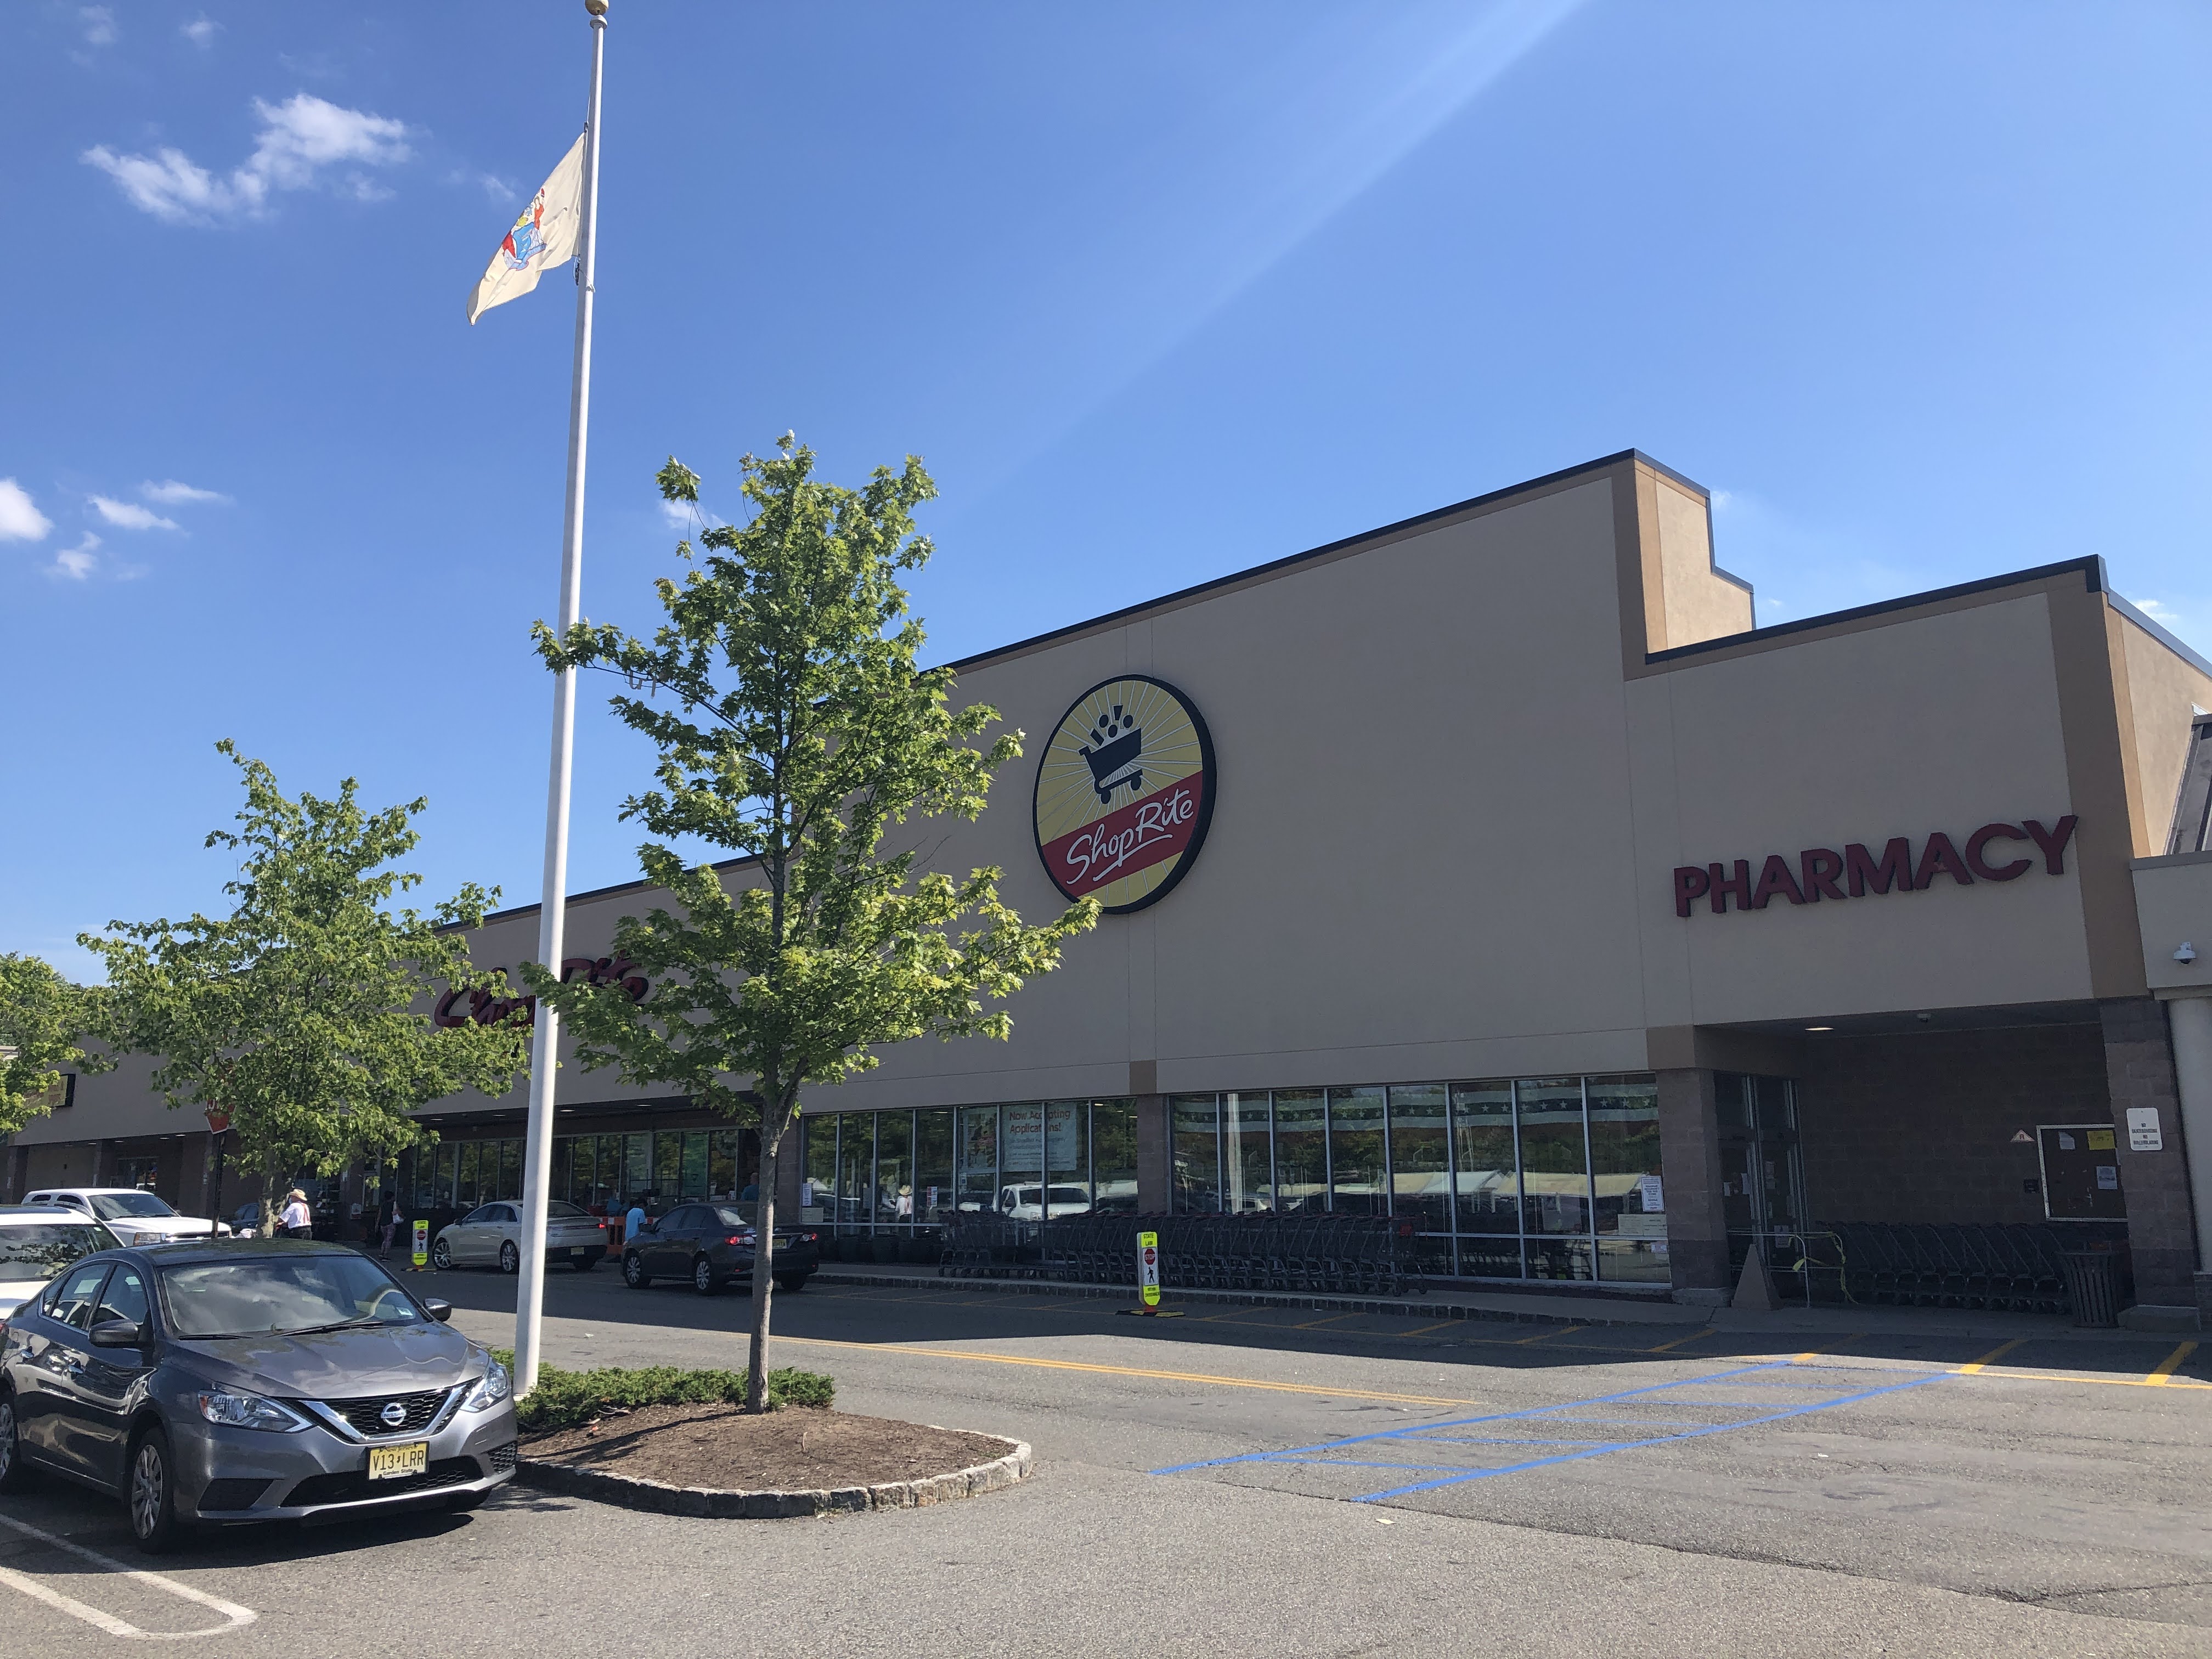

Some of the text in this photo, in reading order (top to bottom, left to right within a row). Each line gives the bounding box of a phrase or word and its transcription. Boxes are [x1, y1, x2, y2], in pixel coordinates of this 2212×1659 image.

[1066, 789, 1194, 884] ShopRite
[1673, 815, 2079, 917] PHARMACY
[1009, 1109, 1070, 1121] Now Accpting
[1009, 1122, 1061, 1135] Applicatns!
